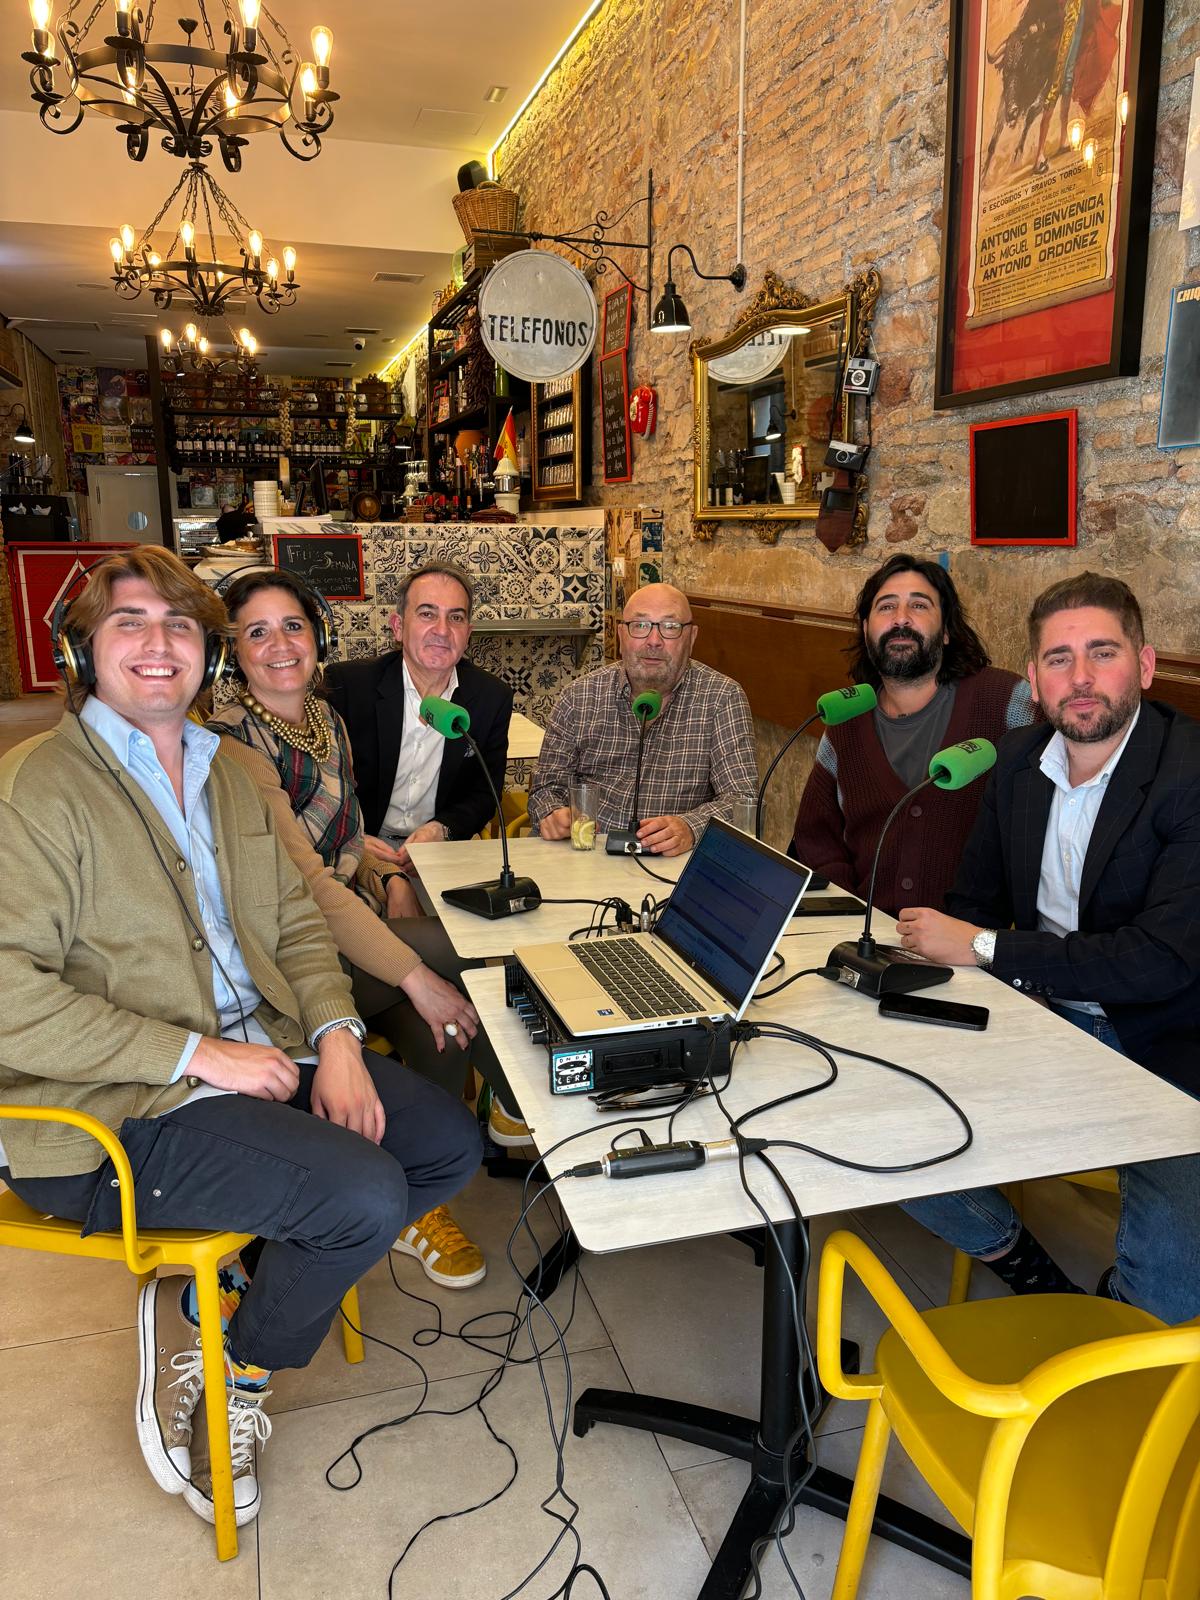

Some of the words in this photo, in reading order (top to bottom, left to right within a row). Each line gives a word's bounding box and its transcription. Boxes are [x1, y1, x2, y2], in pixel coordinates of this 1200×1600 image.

[982, 206, 987, 214] 6
[988, 192, 1022, 211] ESCOGIDOS
[1024, 188, 1029, 196] Y
[1031, 176, 1057, 193] BRAVOS
[1041, 191, 1059, 204] CARLOS
[979, 251, 996, 268] LUIS
[1000, 238, 1029, 259] MIGUEL
[1034, 209, 1104, 249] DOMINGUIN
[981, 222, 1028, 252] ANTONIO
[1033, 192, 1104, 232] BIENVENIDA
[982, 254, 1032, 282] ANTONIO
[1038, 229, 1099, 263] ORDOÑEZ
[488, 314, 588, 347] TELEFONOS
[559, 1055, 587, 1063] ONDA
[557, 1074, 588, 1085] CERO
